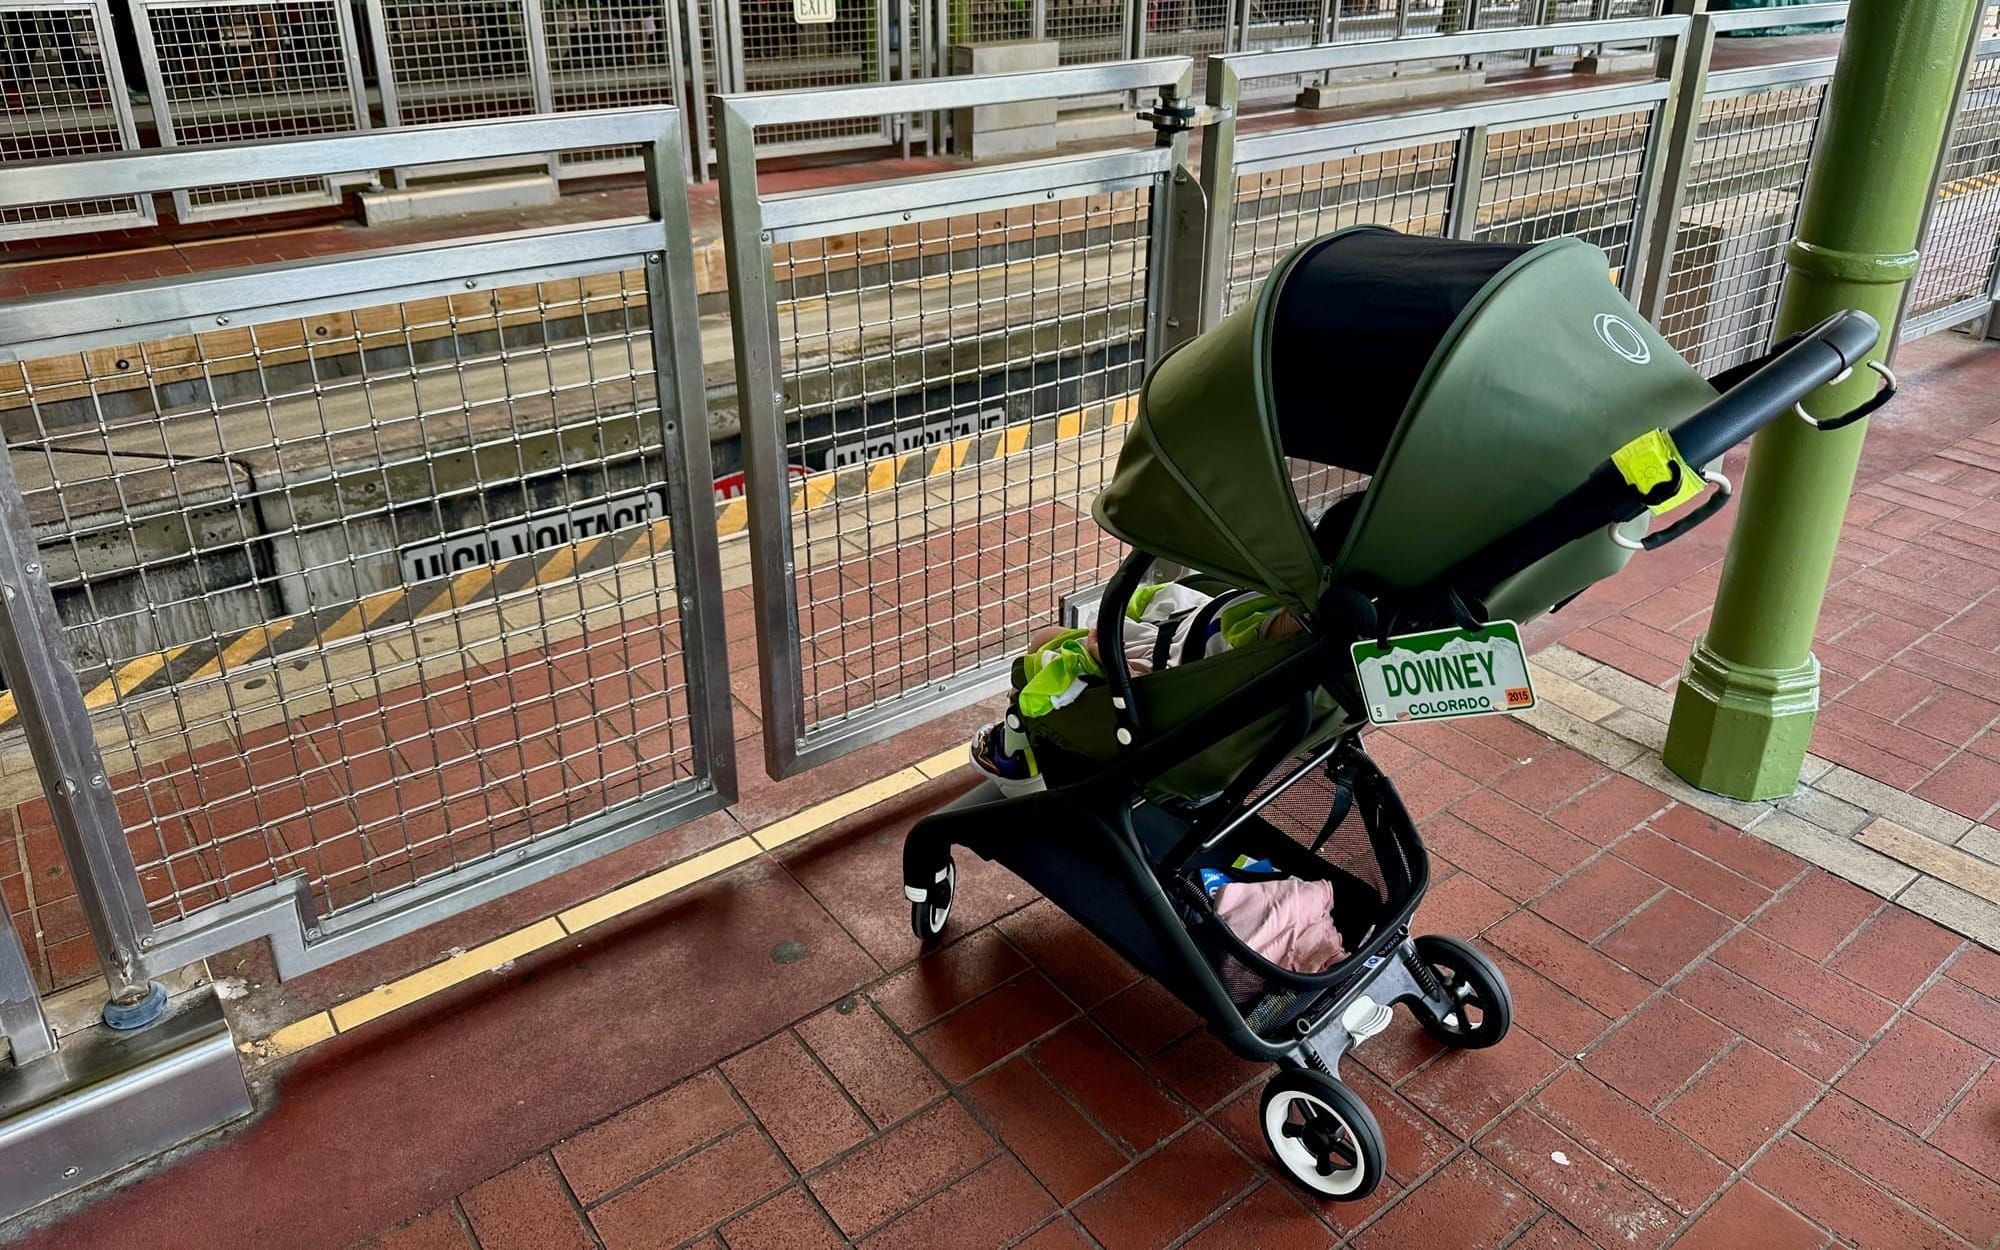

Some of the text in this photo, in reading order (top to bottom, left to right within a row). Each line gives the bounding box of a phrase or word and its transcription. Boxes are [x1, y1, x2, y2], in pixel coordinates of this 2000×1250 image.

[1381, 650, 1495, 697] DOWNEY
[1507, 690, 1529, 702] 2015
[1375, 706, 1383, 718] 5
[1408, 696, 1490, 716] COLORADO
